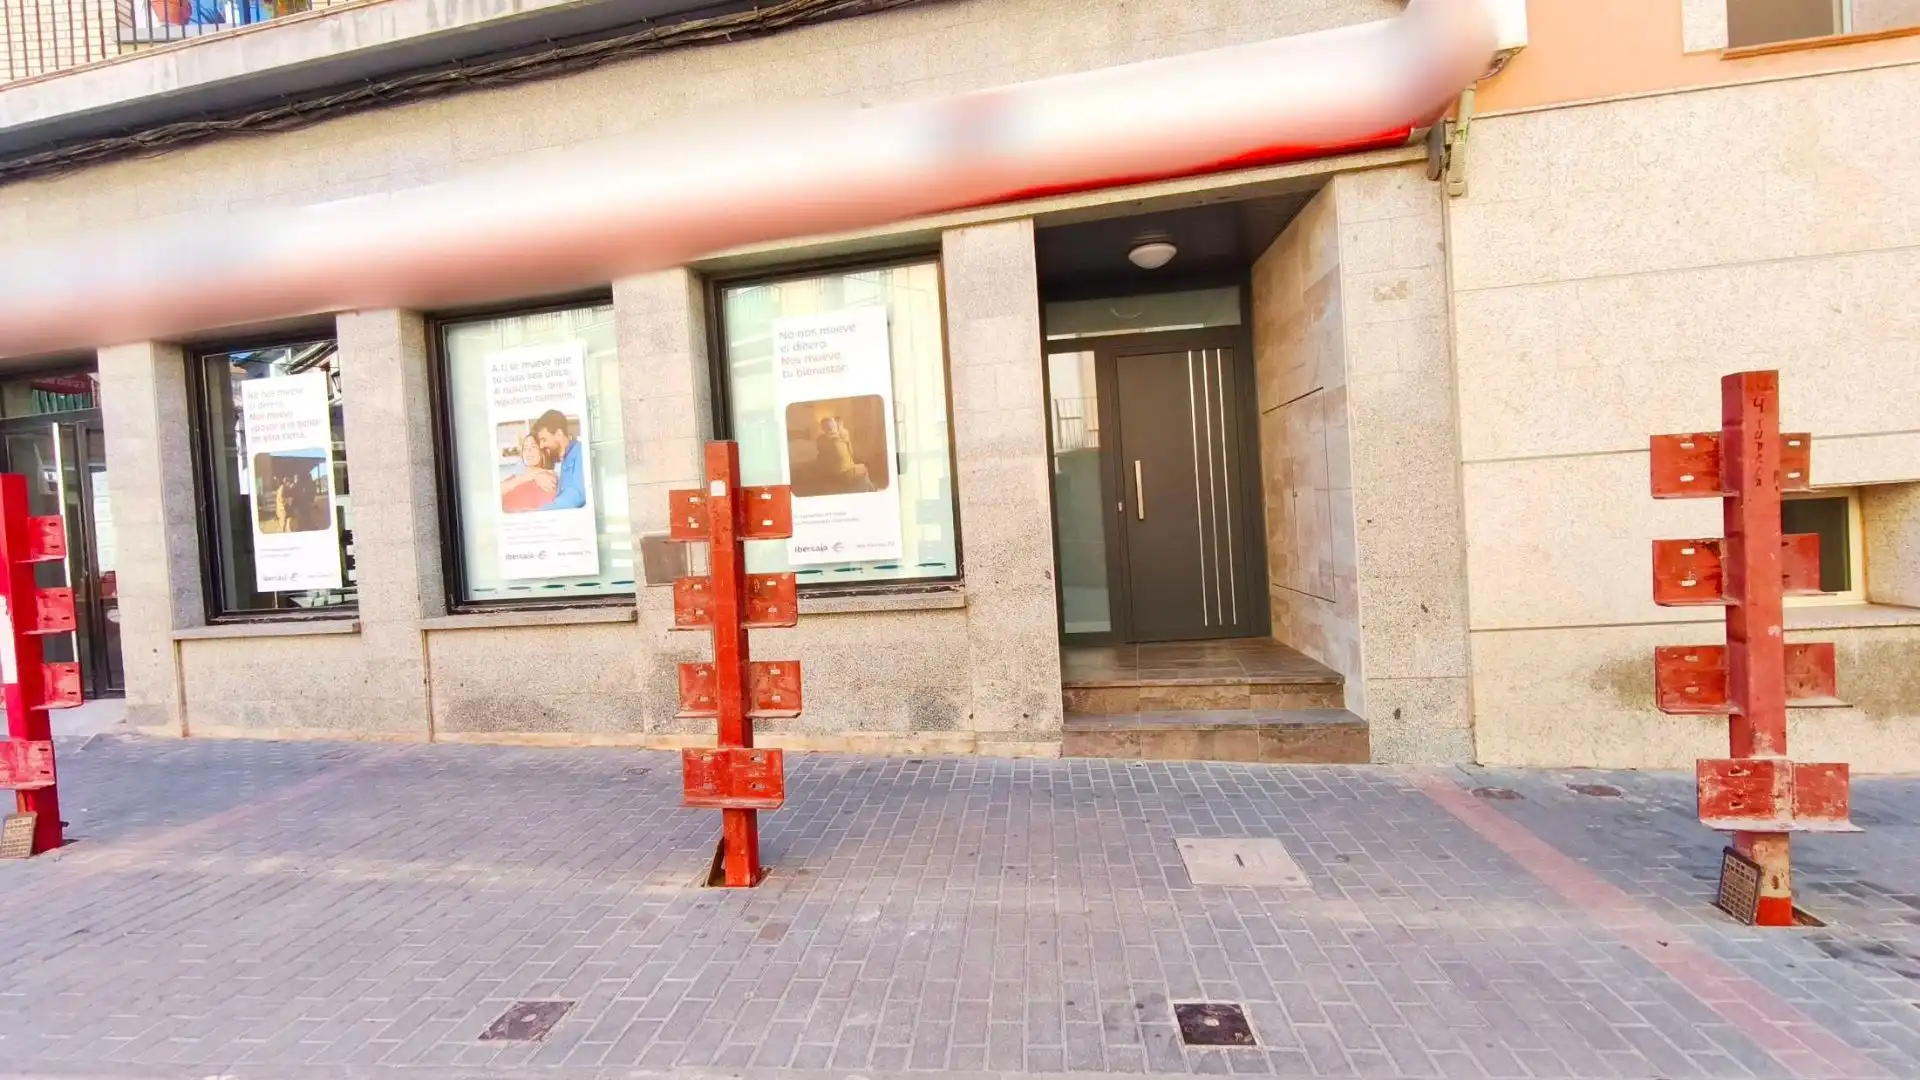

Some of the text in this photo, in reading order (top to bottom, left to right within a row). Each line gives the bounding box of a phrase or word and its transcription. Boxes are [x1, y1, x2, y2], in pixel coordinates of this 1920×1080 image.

[779, 323, 856, 340] No nos mueve
[781, 352, 842, 365] Nos mueve
